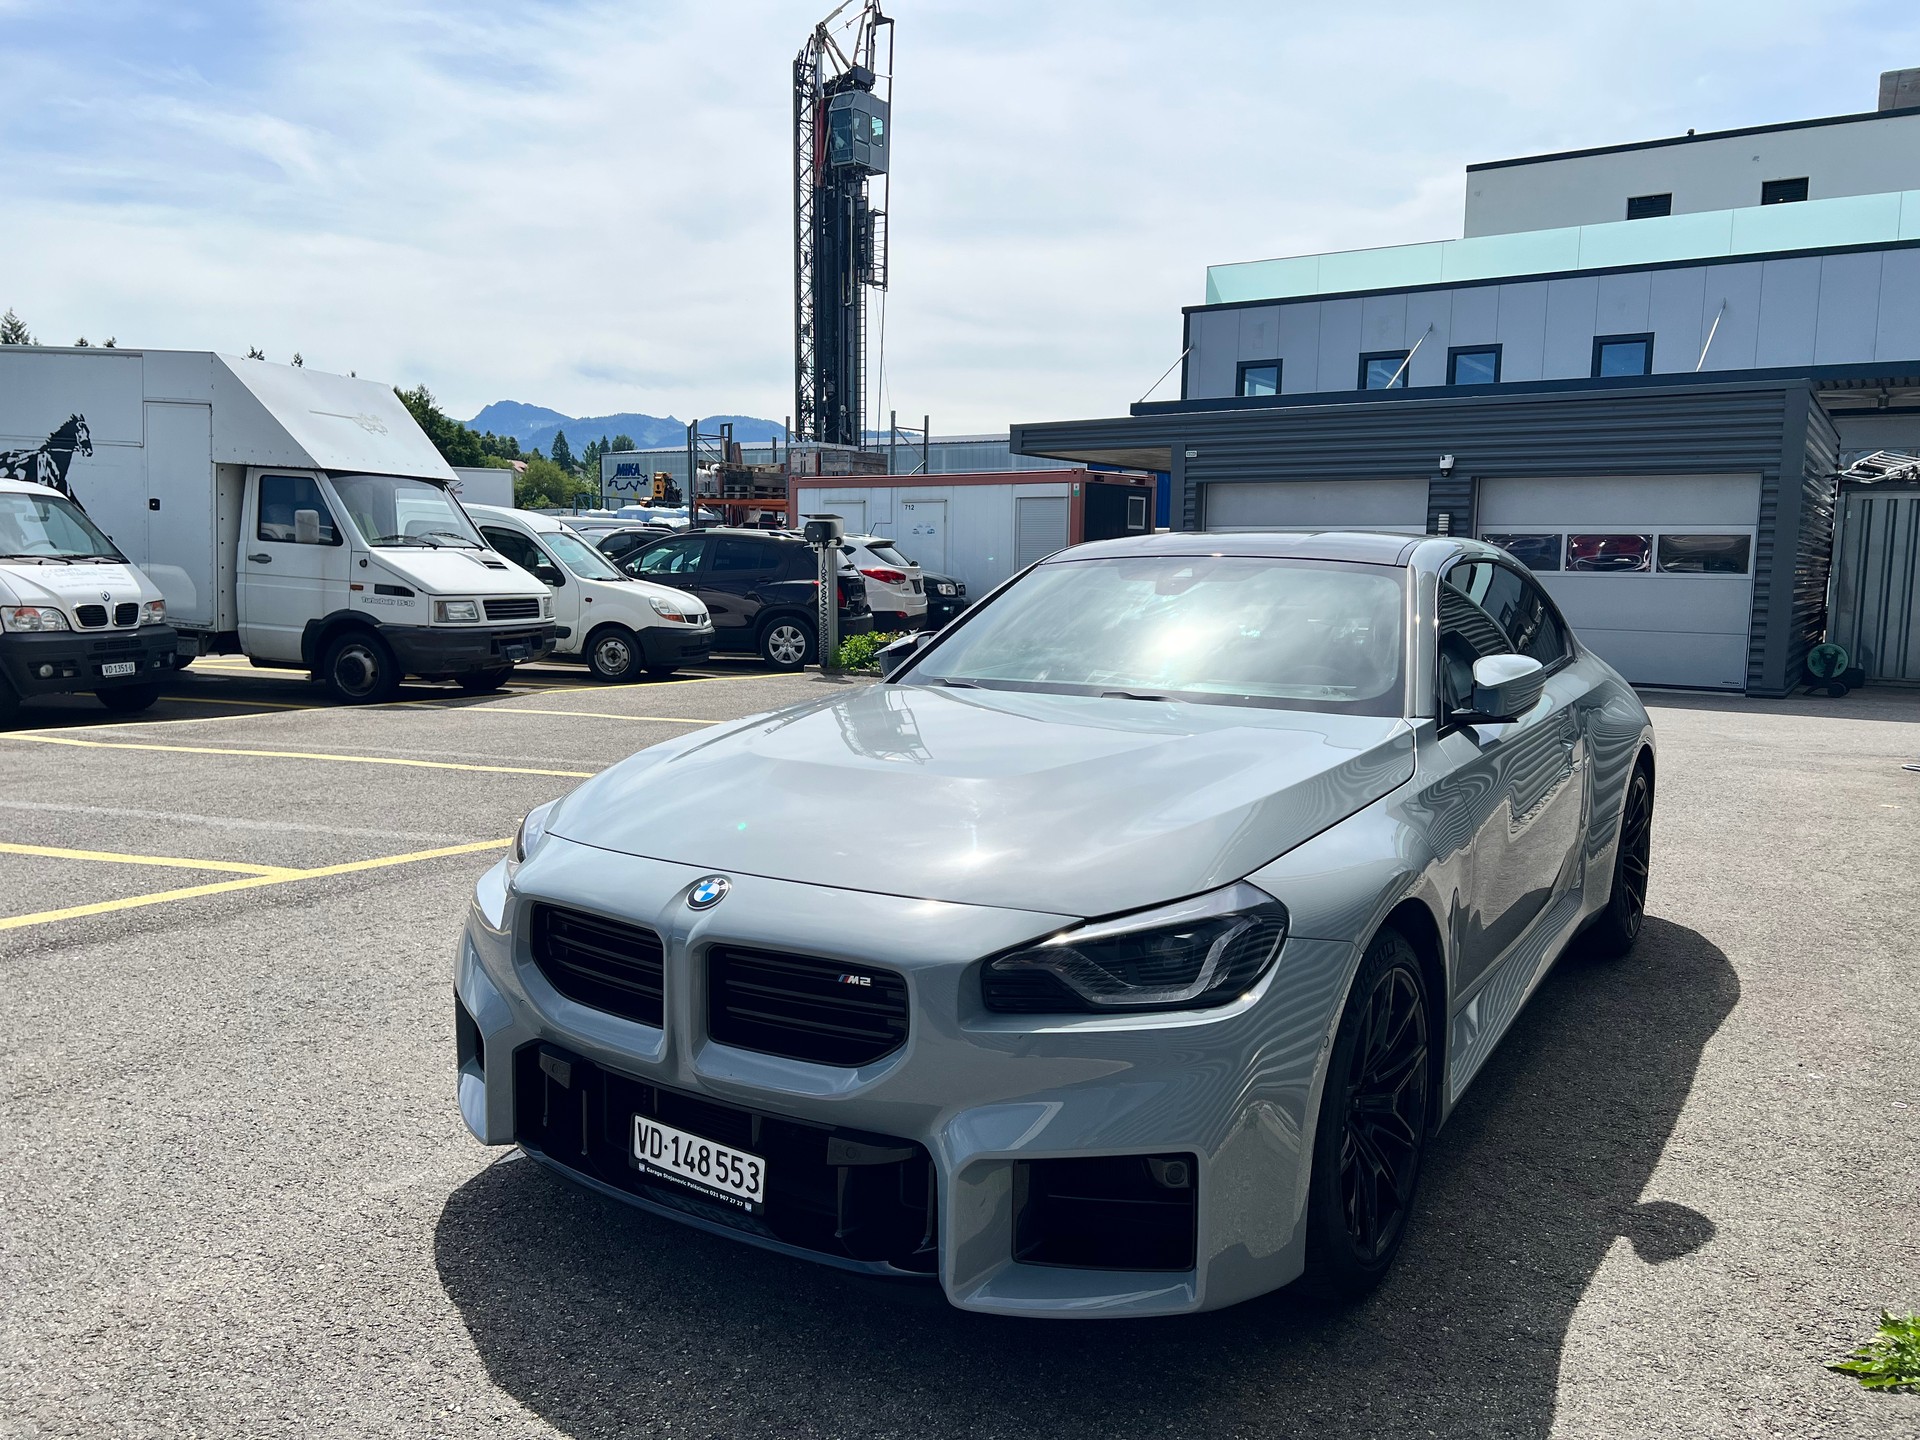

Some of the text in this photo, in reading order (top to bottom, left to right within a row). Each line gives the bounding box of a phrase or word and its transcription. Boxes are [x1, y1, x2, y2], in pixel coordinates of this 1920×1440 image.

[616, 463, 640, 476] MIKA
[646, 1167, 663, 1177] Garage
[709, 1190, 719, 1198] 021
[719, 1194, 729, 1202] 907
[729, 1197, 737, 1205] 27
